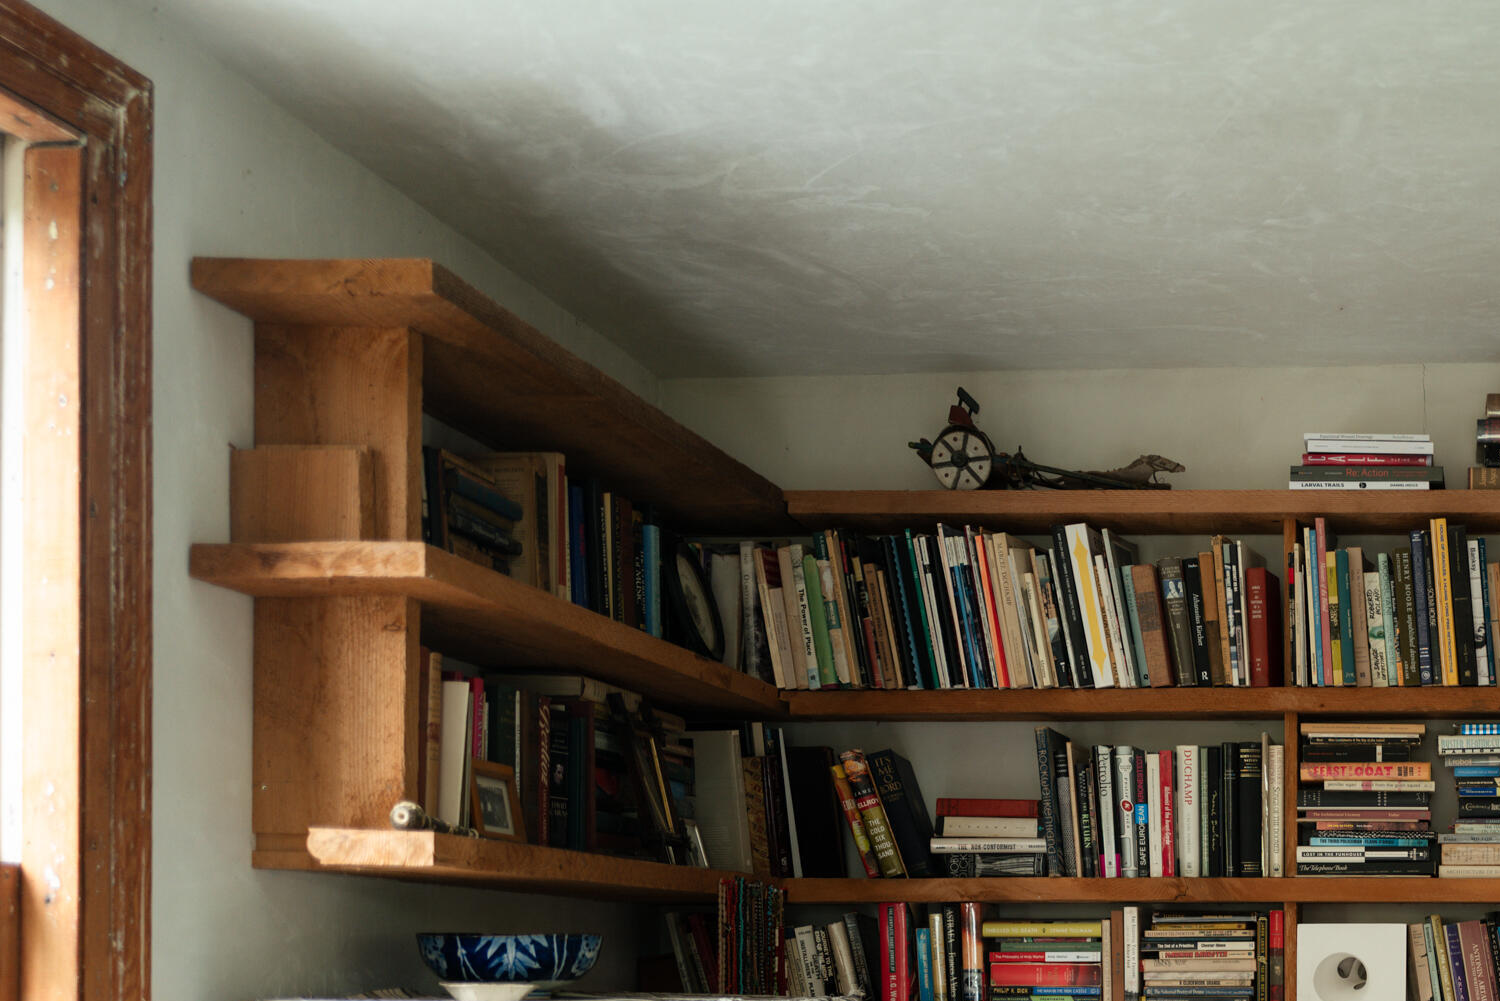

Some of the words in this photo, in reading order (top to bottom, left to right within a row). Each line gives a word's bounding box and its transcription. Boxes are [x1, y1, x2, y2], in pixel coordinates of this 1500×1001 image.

[1361, 469, 1389, 478] Action
[1402, 553, 1411, 581] HENRY
[1469, 548, 1477, 572] Banksy
[1404, 584, 1413, 613] MOORE
[1192, 594, 1203, 624] Athanasius
[1428, 608, 1437, 627] HOUSE
[1195, 626, 1205, 646] Kircher
[1405, 615, 1416, 648] unpublished
[1408, 649, 1418, 673] drawings
[878, 766, 894, 776] ME
[884, 774, 893, 784] O
[1097, 753, 1111, 796] Petrolio
[1183, 750, 1193, 805] DUCHAMP
[1313, 766, 1347, 777] FEAST
[1355, 766, 1393, 776] GOAT
[856, 797, 879, 809] ELLROY
[868, 819, 881, 827] THE
[870, 825, 886, 835] COLD
[1081, 814, 1091, 848] RETURN
[1137, 805, 1146, 845] EUROPEAN
[874, 835, 886, 844] SIX
[874, 842, 893, 851] THOU-
[877, 848, 894, 859] SAND
[1139, 847, 1147, 865] SAFE
[800, 939, 811, 979] INSTALLMENT
[1471, 943, 1484, 977] ANTONIN
